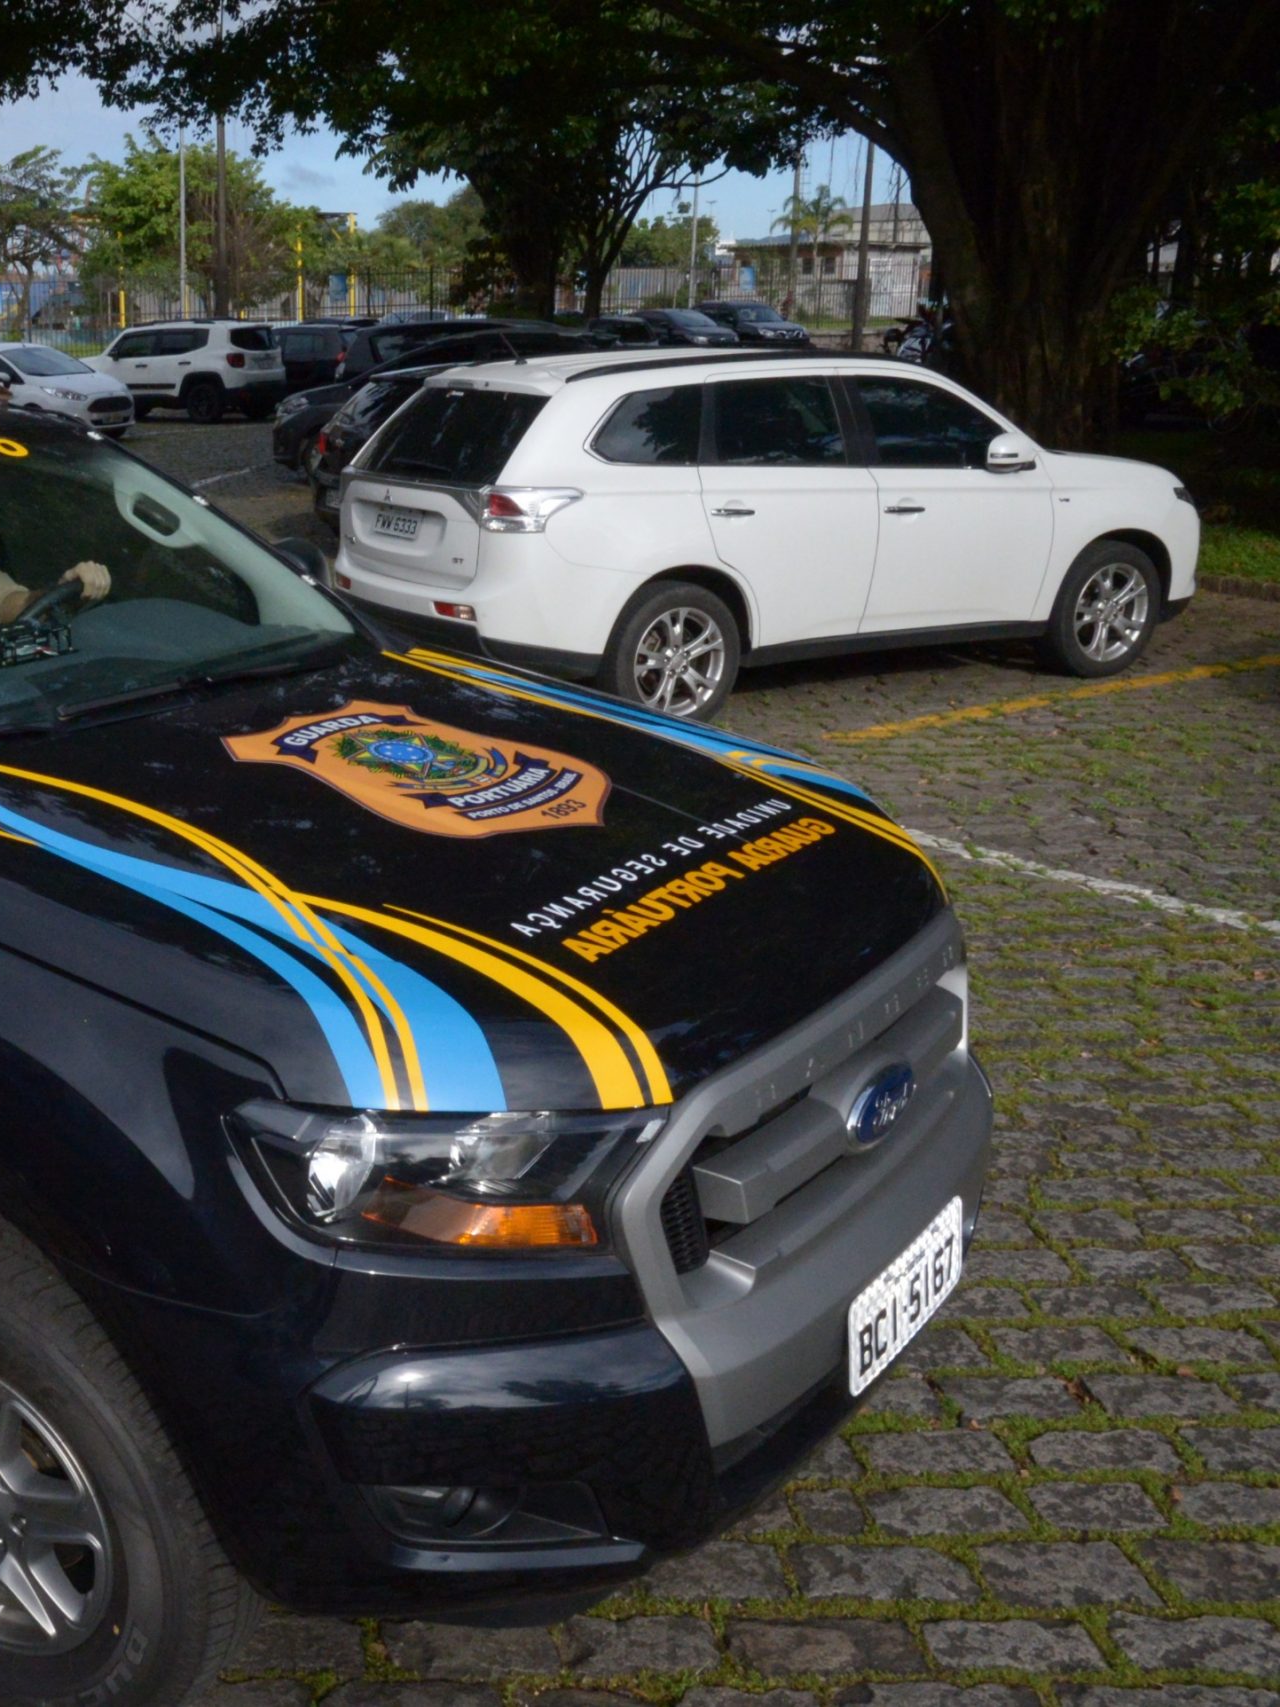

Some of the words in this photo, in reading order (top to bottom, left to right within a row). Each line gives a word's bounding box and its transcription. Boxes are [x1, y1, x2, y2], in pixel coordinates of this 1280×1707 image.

[283, 713, 383, 748] GUARDA
[447, 767, 551, 808] PORTUÁRIA
[540, 799, 587, 820] 1893
